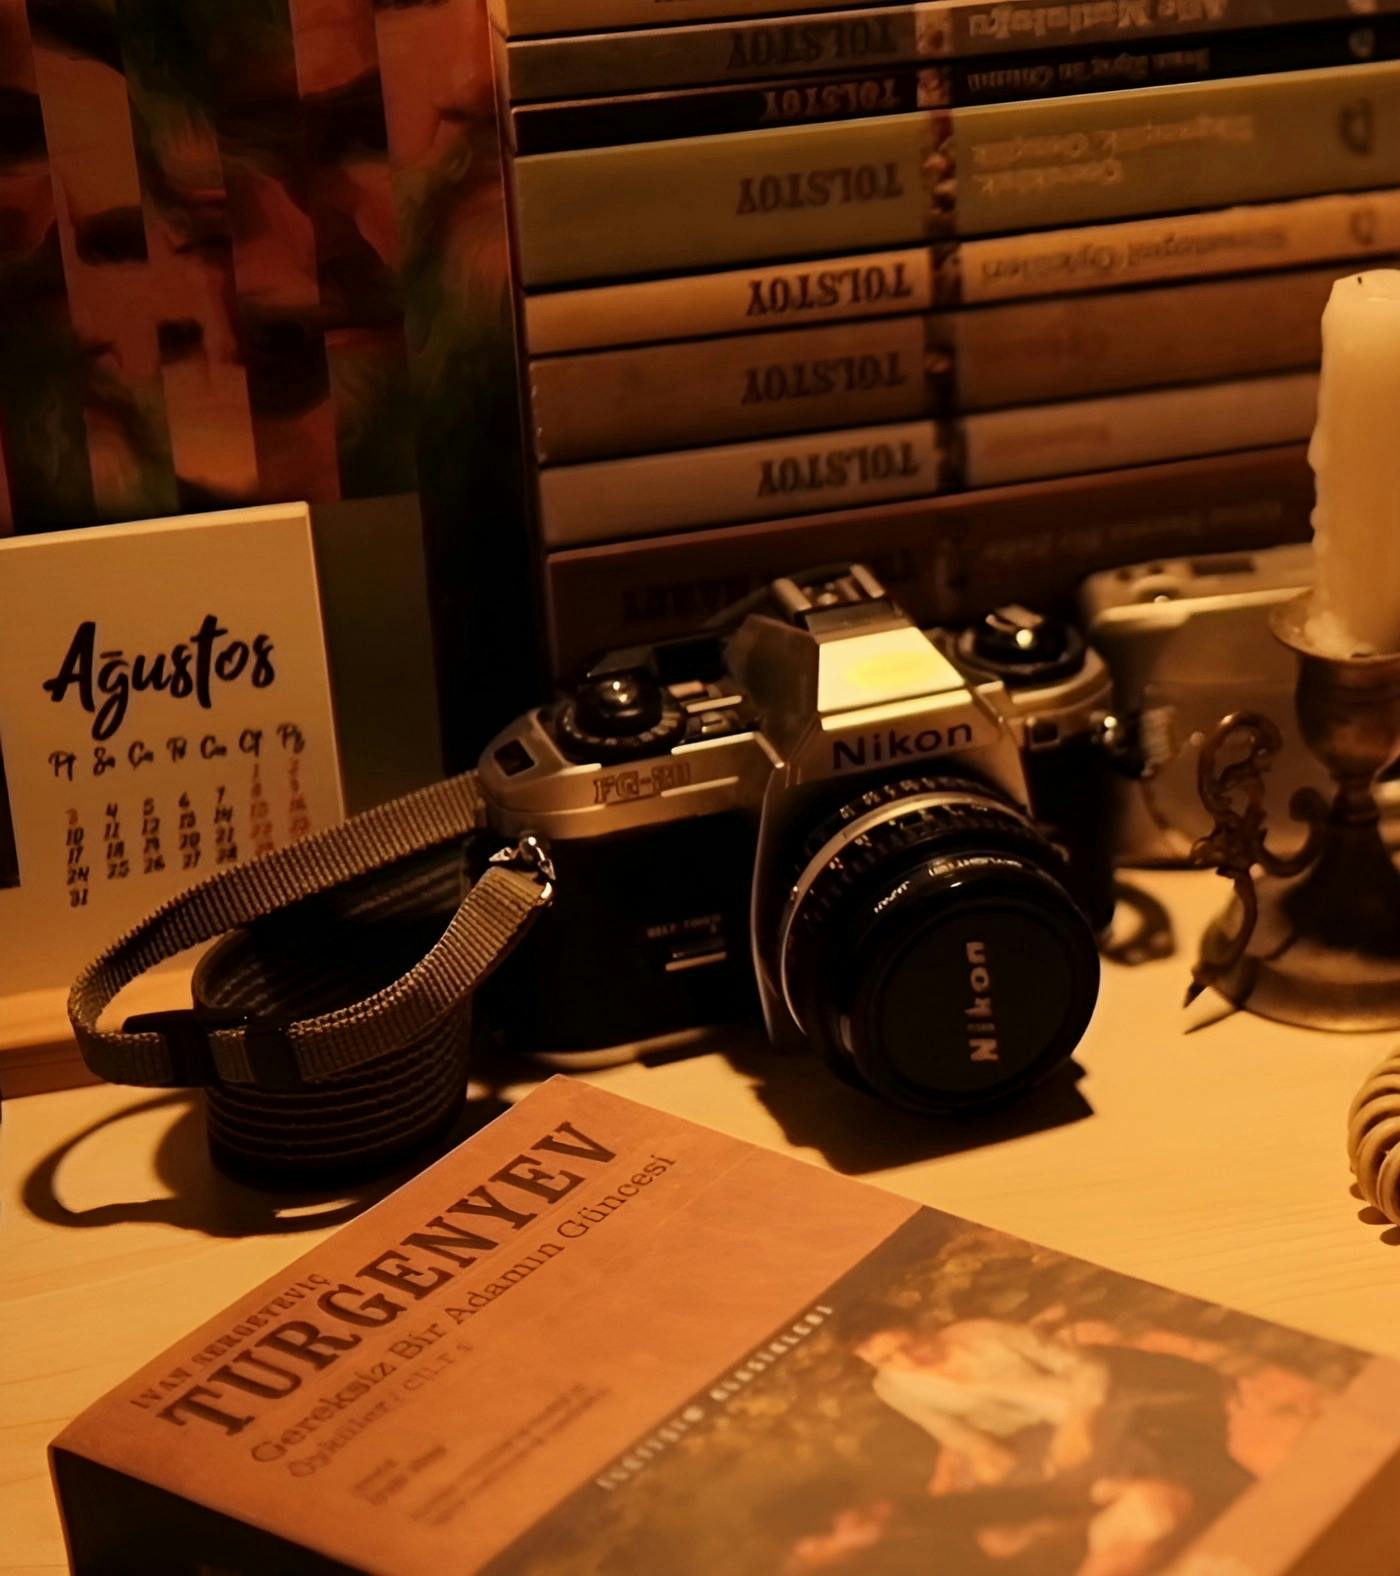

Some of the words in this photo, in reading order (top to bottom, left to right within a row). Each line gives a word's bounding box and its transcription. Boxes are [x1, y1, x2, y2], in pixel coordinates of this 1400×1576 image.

[726, 16, 896, 69] TOLSTOY
[763, 77, 898, 120] TOLSTOY
[736, 162, 904, 214] TOLSTOY
[746, 263, 912, 316] TOLSTOY
[741, 352, 906, 405] TOLSTOY
[757, 442, 920, 497] TOLSTOY
[43, 614, 275, 740] Ağustos
[833, 724, 972, 769] Nikon
[66, 827, 85, 846] 10
[104, 822, 120, 841] 11
[214, 806, 234, 825] 14
[106, 803, 118, 820] 4
[67, 866, 90, 886] 24
[68, 846, 85, 865] 17
[963, 941, 999, 1062] Nikon
[156, 1121, 617, 1436] TURGENYEV
[251, 1361, 398, 1463] Gereksiz
[388, 1322, 447, 1361] Bir
[444, 1241, 566, 1325] Adamın
[556, 1154, 677, 1238] Güncesi
